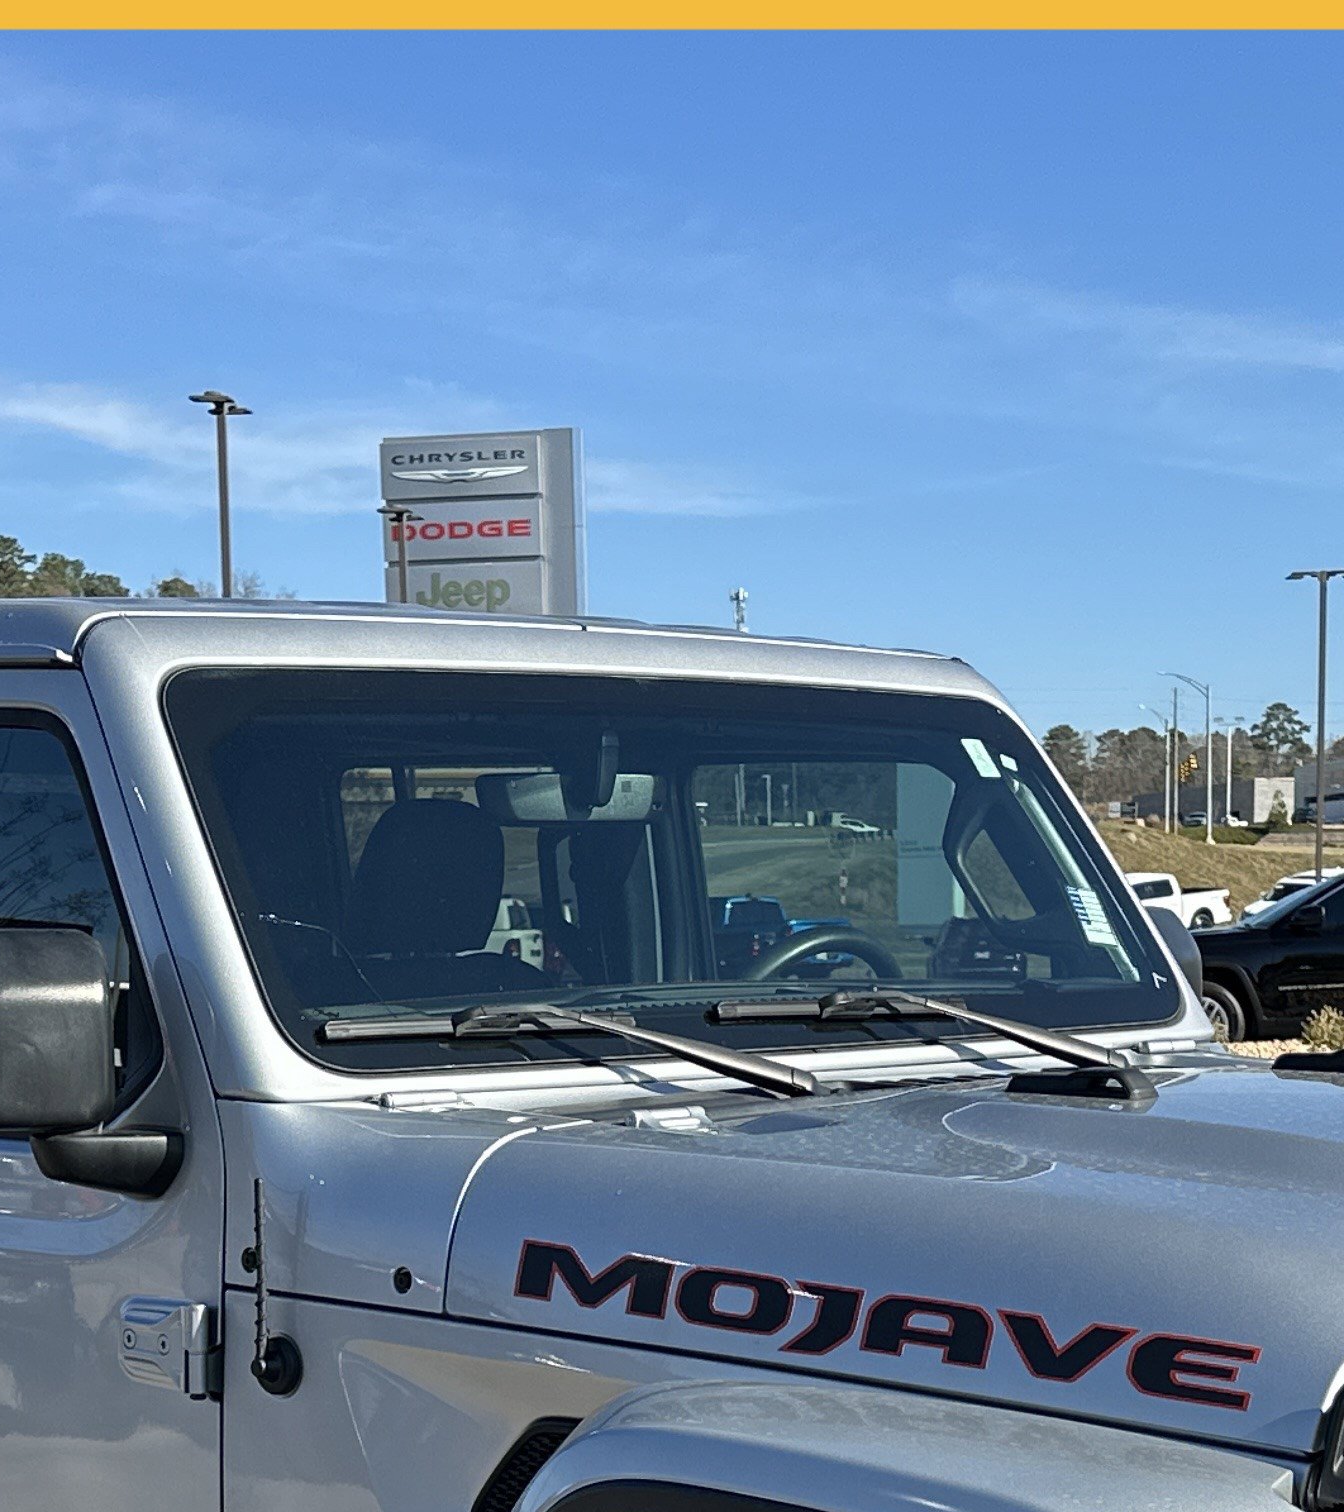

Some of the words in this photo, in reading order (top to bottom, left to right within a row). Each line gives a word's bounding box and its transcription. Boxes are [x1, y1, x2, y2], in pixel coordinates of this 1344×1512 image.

[391, 449, 526, 466] CHRYSLER
[391, 518, 532, 542] DODGE
[416, 572, 511, 613] Jeep
[513, 1239, 1262, 1412] MOJAVE
